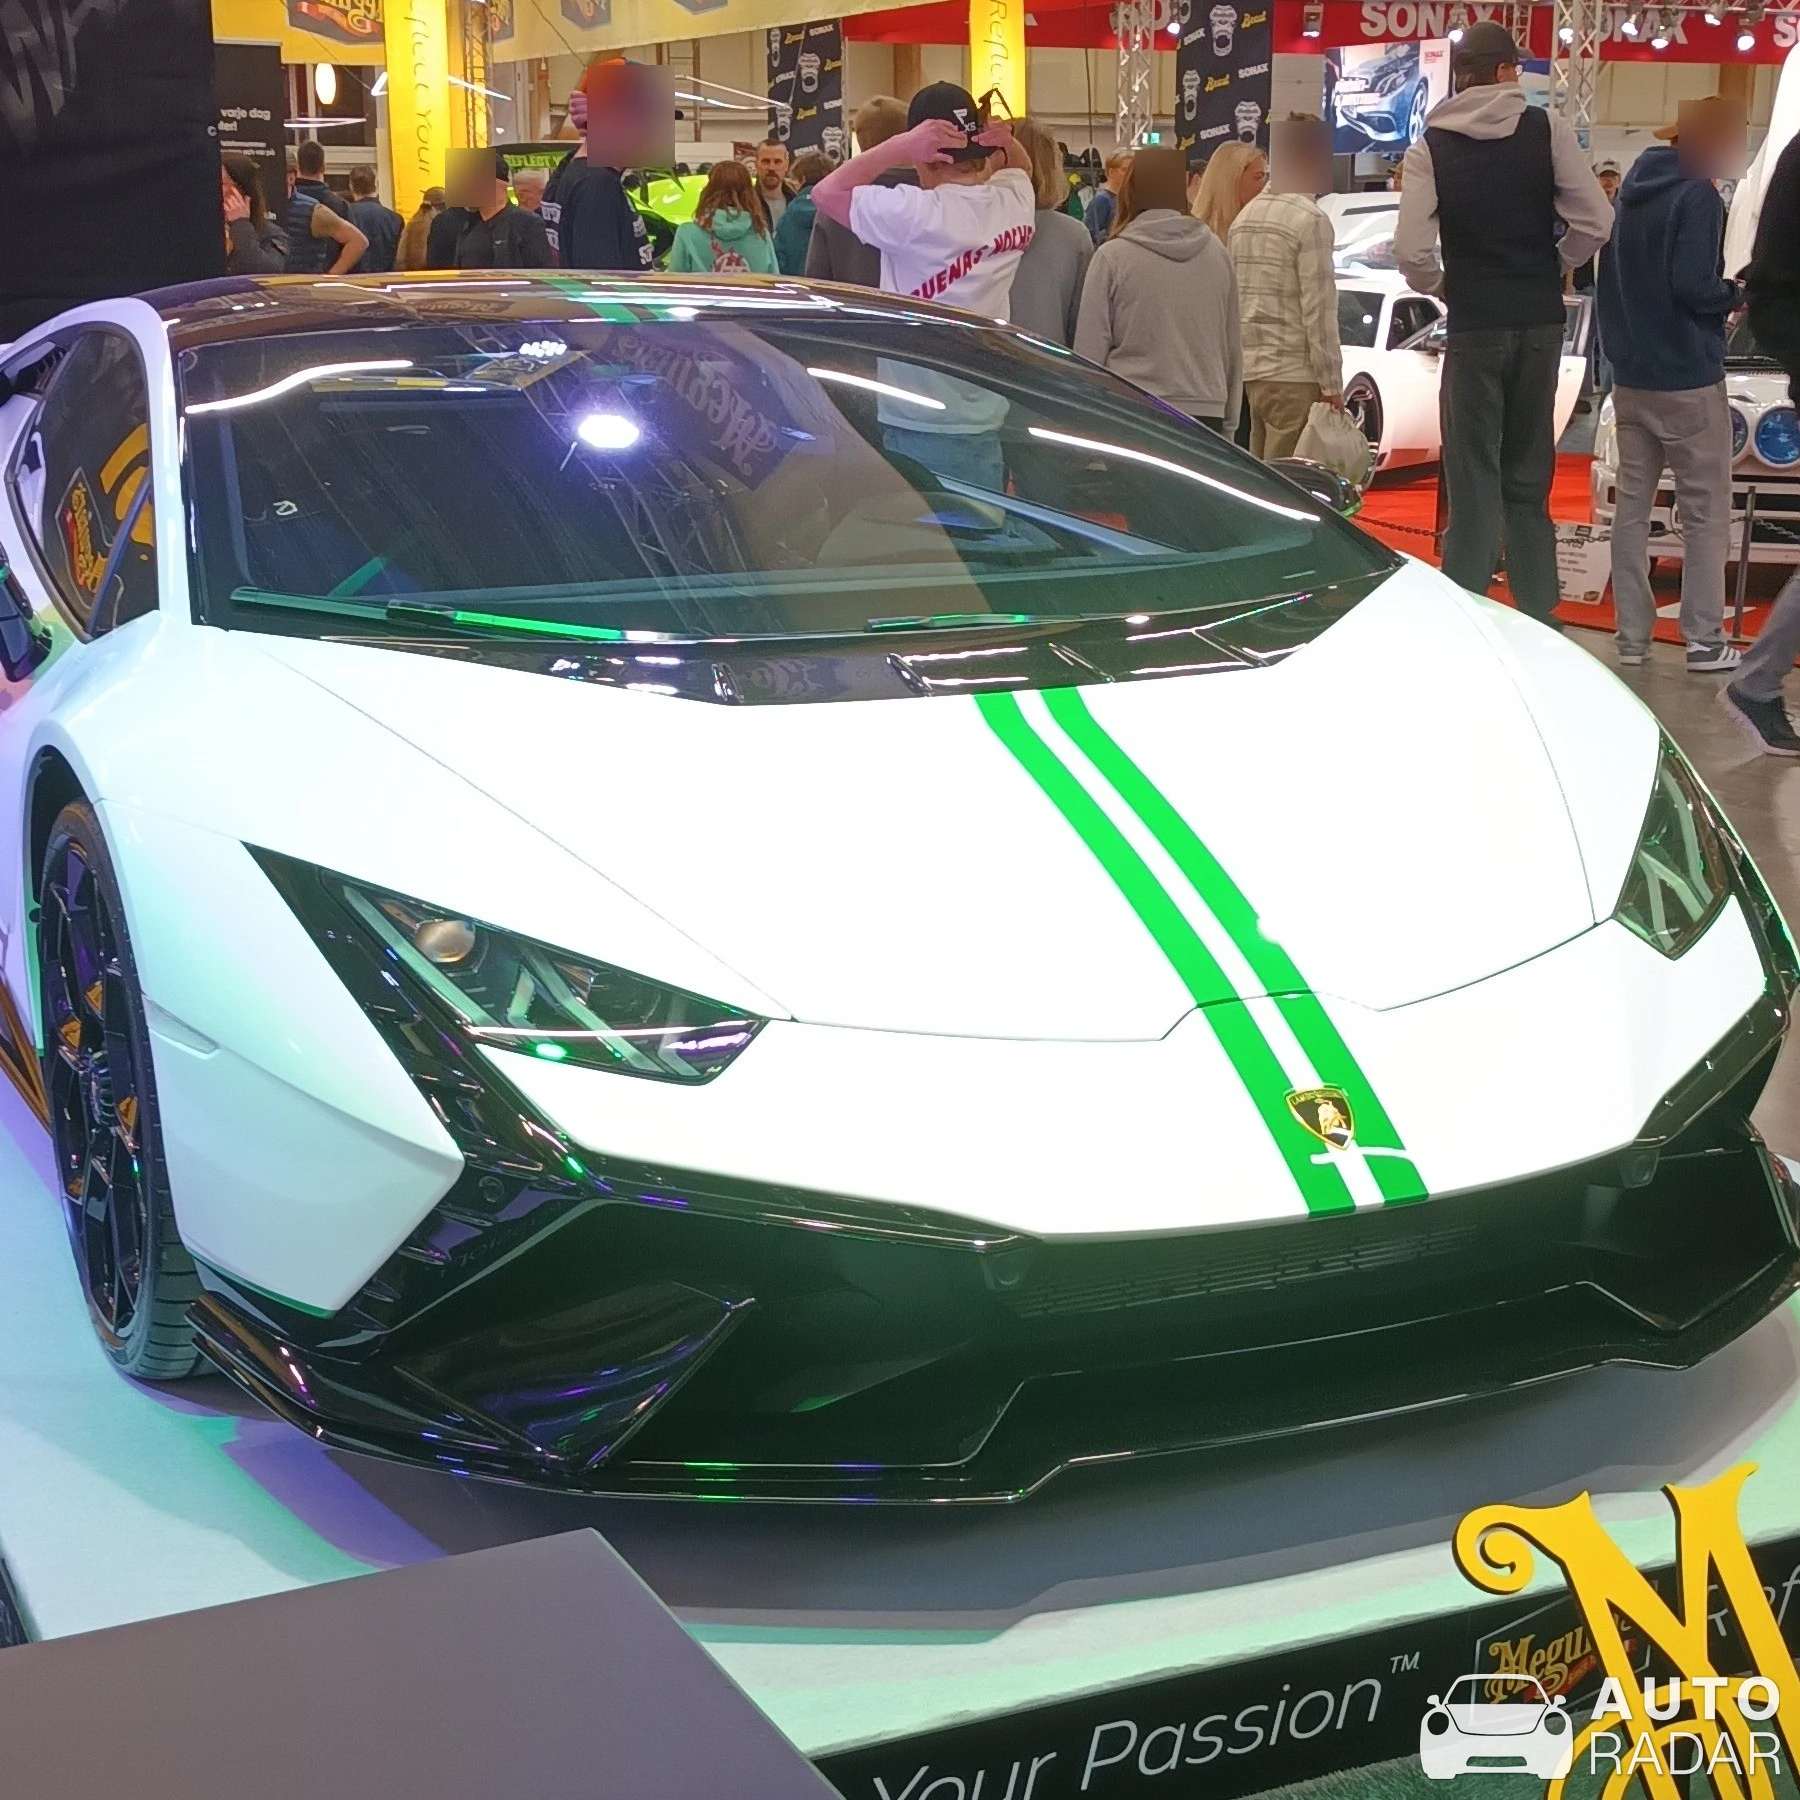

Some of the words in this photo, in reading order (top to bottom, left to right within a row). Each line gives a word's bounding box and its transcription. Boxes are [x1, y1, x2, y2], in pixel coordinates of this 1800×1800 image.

[1238, 62, 1269, 79] SONAX
[416, 109, 433, 173] Your
[1080, 1678, 1382, 1791] Passion
